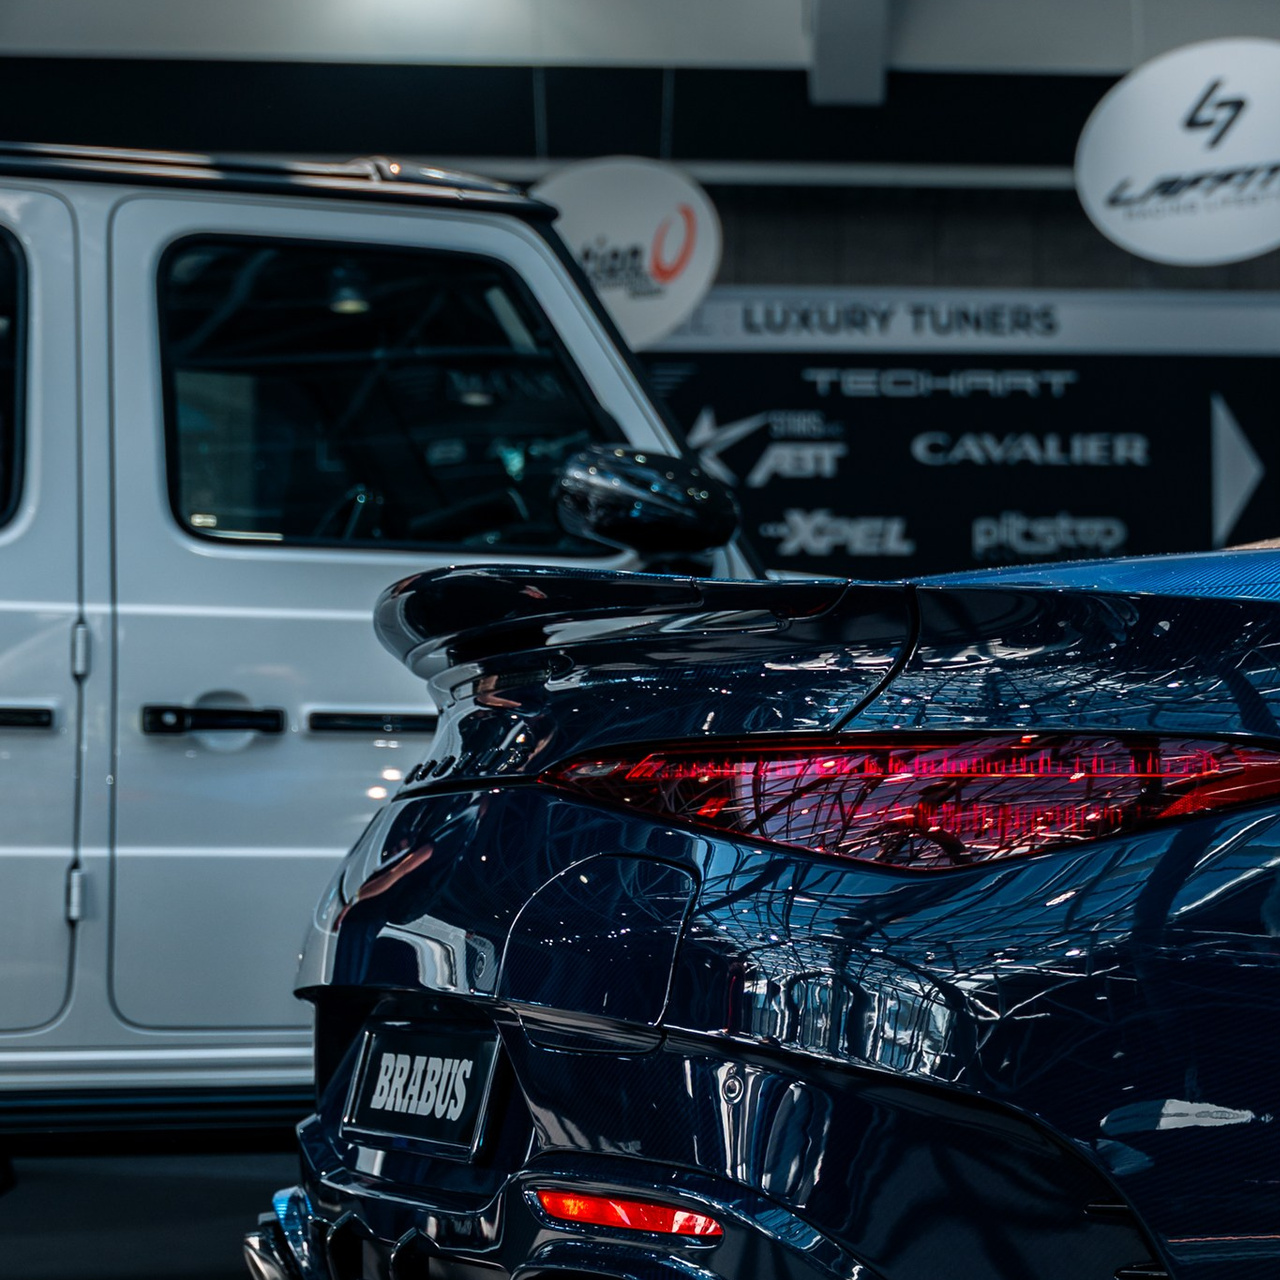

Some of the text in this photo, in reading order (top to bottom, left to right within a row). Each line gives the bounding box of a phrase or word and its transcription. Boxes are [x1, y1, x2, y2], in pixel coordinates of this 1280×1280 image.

[741, 302, 895, 337] LUXURY
[906, 302, 1060, 337] TUNERS
[802, 366, 1077, 398] TECHART
[746, 441, 849, 488] ABT
[909, 431, 1150, 467] CAVALIER
[776, 508, 918, 557] XPEL
[369, 1052, 474, 1121] BRABUS
